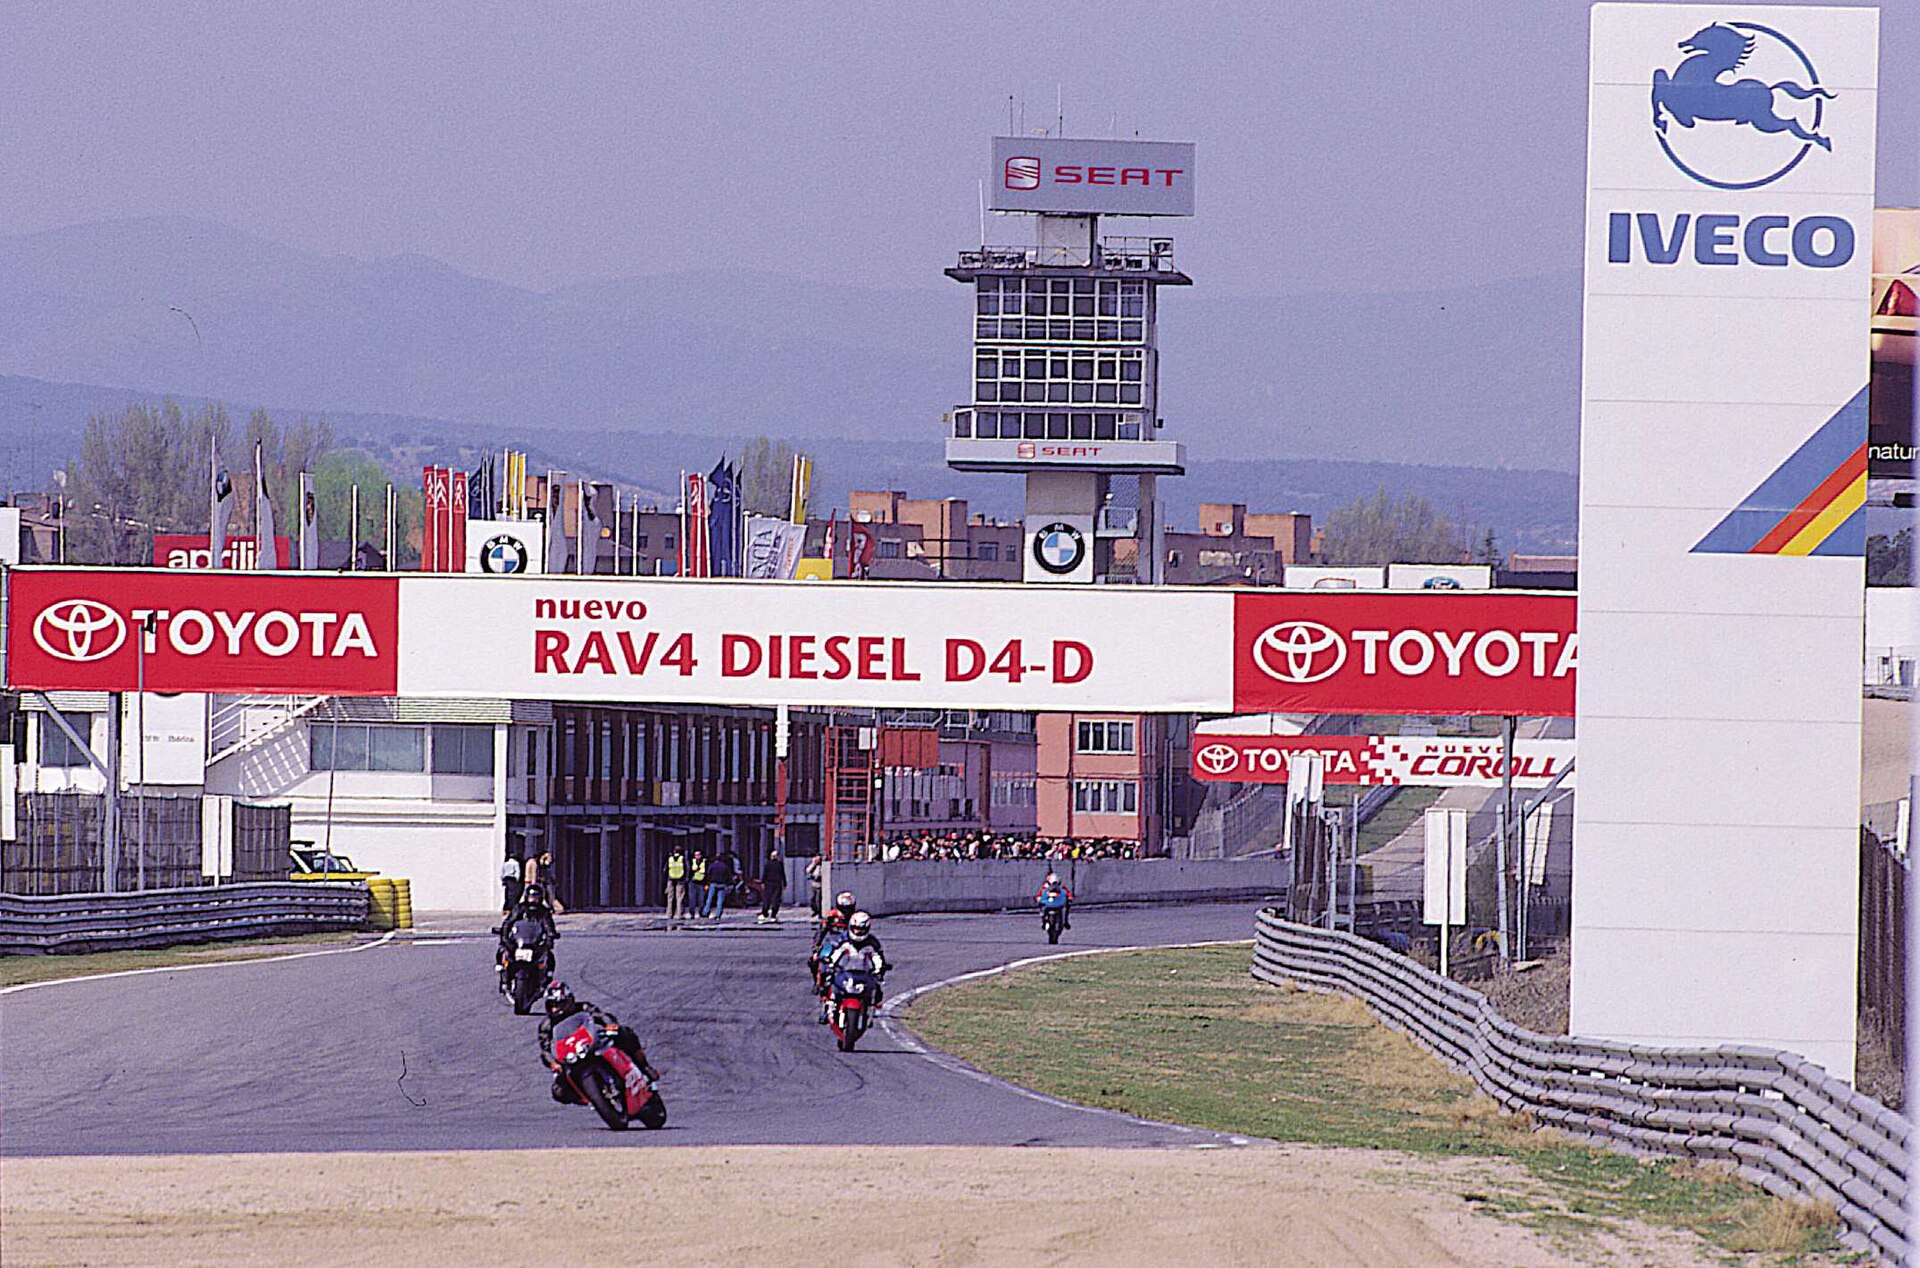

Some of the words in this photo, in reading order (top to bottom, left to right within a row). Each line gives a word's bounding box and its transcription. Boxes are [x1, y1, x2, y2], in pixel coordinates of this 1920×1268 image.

[1054, 166, 1183, 187] SEAT
[1608, 212, 1855, 268] IVECO
[1042, 446, 1102, 457] SEAT
[535, 598, 647, 621] nuevo
[131, 609, 378, 657] TOYOTA
[534, 630, 698, 677] RAV4
[721, 634, 921, 681] DIESEL
[945, 639, 1094, 684] D4-D
[1242, 747, 1357, 773] TOYTA
